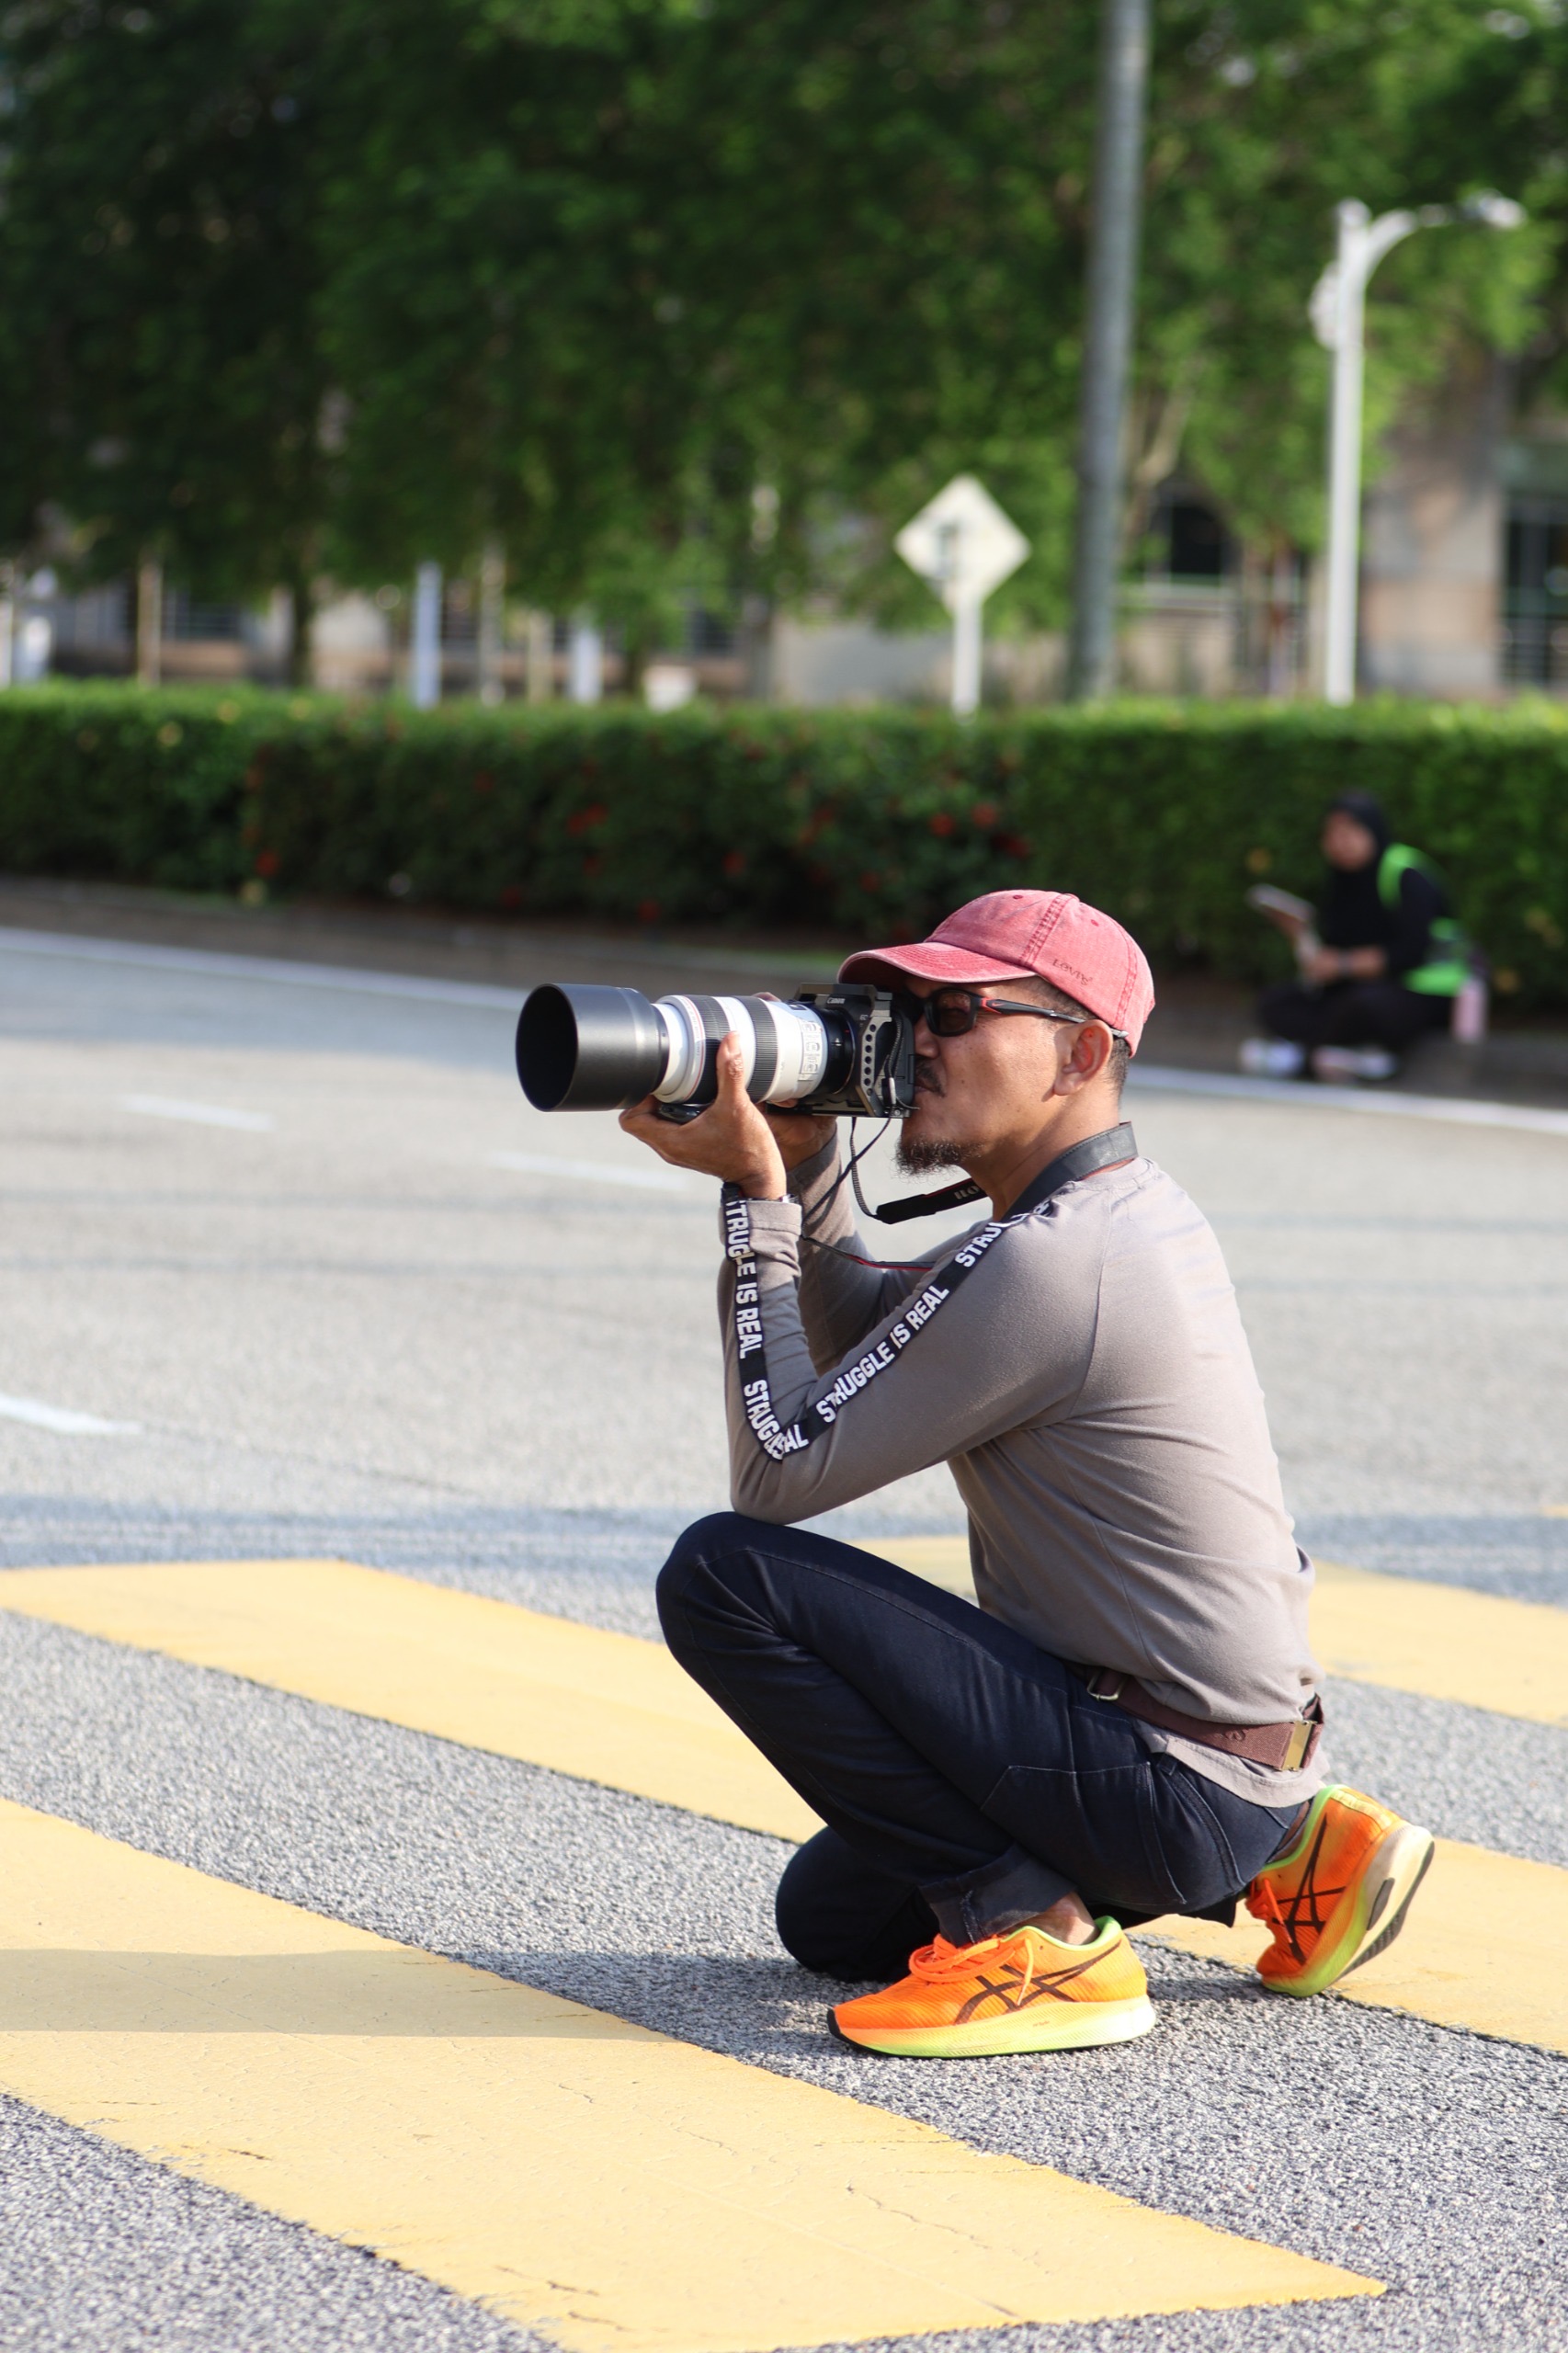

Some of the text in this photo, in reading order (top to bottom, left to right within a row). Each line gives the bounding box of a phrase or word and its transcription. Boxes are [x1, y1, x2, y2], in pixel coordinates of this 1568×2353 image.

[735, 1282, 758, 1304] IS
[736, 1308, 763, 1359] REAL
[816, 1342, 895, 1423] STRUGGLE
[889, 1323, 912, 1349] IS
[905, 1285, 950, 1331] REAL
